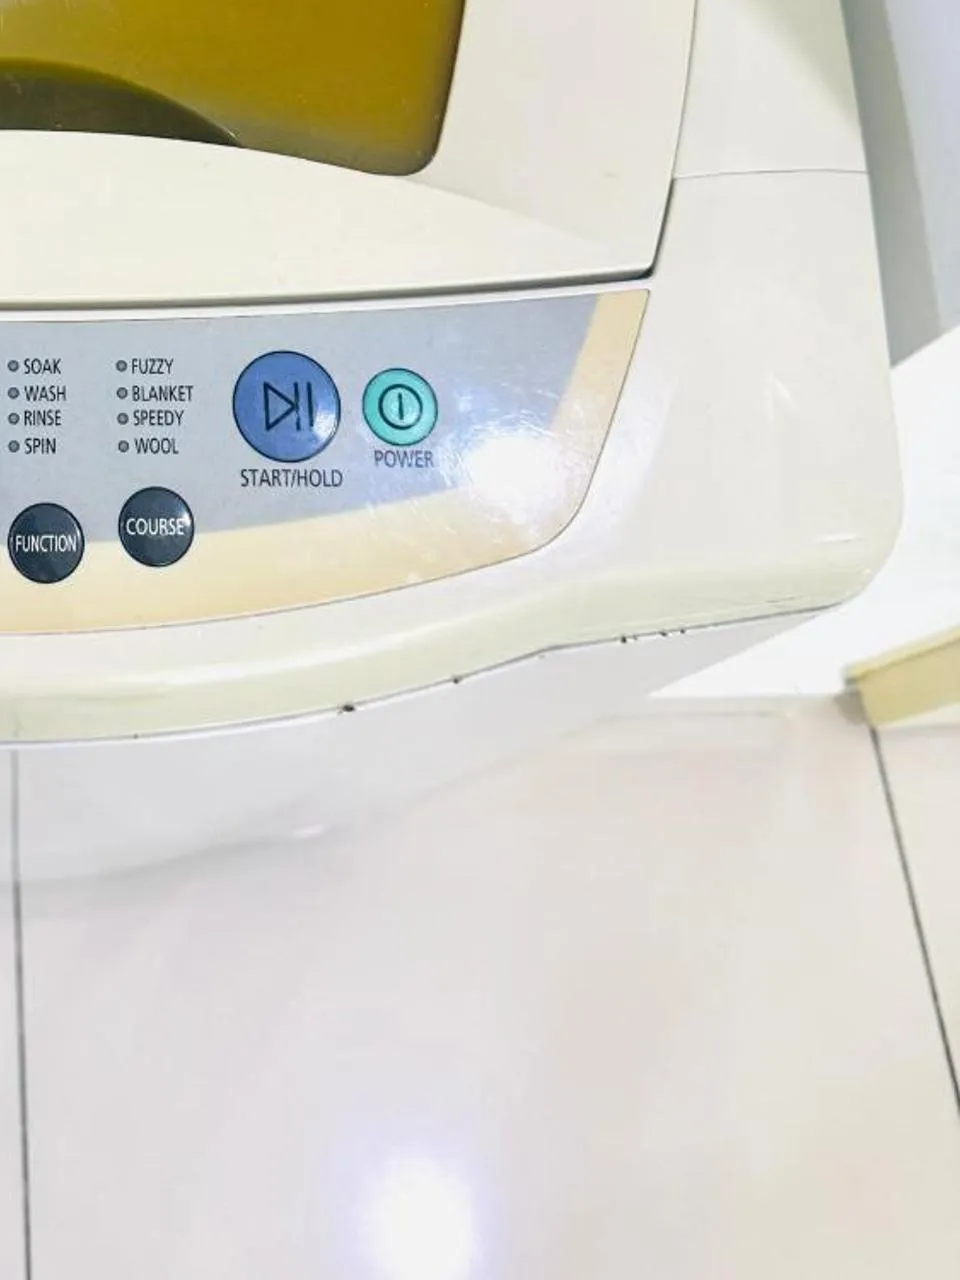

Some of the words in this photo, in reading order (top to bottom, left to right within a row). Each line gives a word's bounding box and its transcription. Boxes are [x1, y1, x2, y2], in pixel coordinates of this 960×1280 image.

[23, 358, 62, 375] SOAK
[131, 358, 174, 375] FUZZY
[24, 386, 67, 402] WASH
[132, 385, 194, 402] BLANKET
[23, 410, 62, 426] RINSE
[133, 410, 184, 427] SPEEDY
[24, 438, 57, 454] SPIN
[134, 438, 179, 454] WOOL
[374, 450, 434, 469] POWER
[240, 469, 343, 488] START/HOLD
[126, 518, 185, 537] COURSE
[15, 535, 77, 553] FUNCTION
